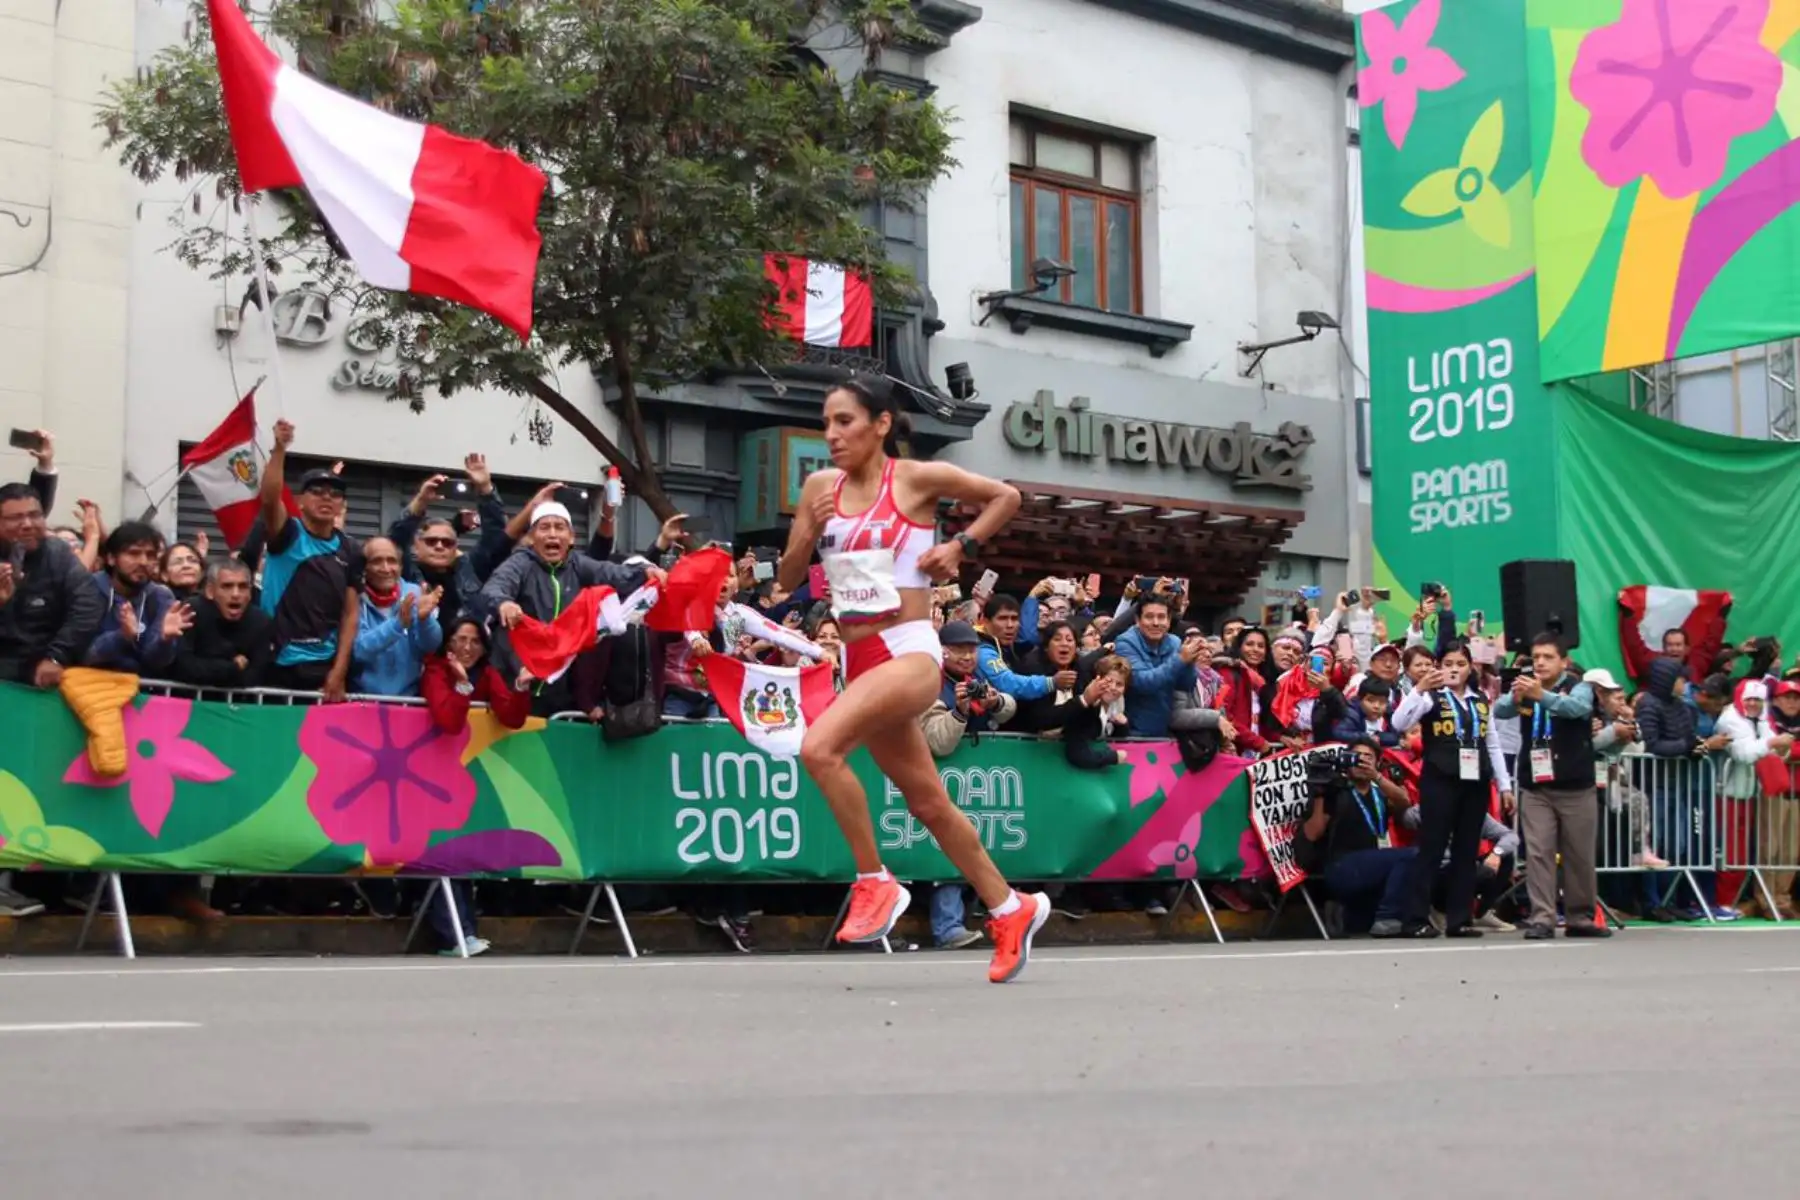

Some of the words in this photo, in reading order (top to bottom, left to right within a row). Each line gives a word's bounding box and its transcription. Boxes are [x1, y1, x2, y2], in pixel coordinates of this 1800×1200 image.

[1409, 383, 1514, 443] 2019
[1002, 389, 1295, 480] chinawok
[1411, 459, 1508, 501] PANAM
[1409, 491, 1512, 533] SPORTS
[884, 766, 1024, 807] PNAM
[1254, 784, 1285, 809] CON
[1290, 780, 1309, 802] TO
[675, 807, 800, 863] 2019
[880, 809, 1028, 851] SPTS
[1261, 801, 1309, 827] VAMO
